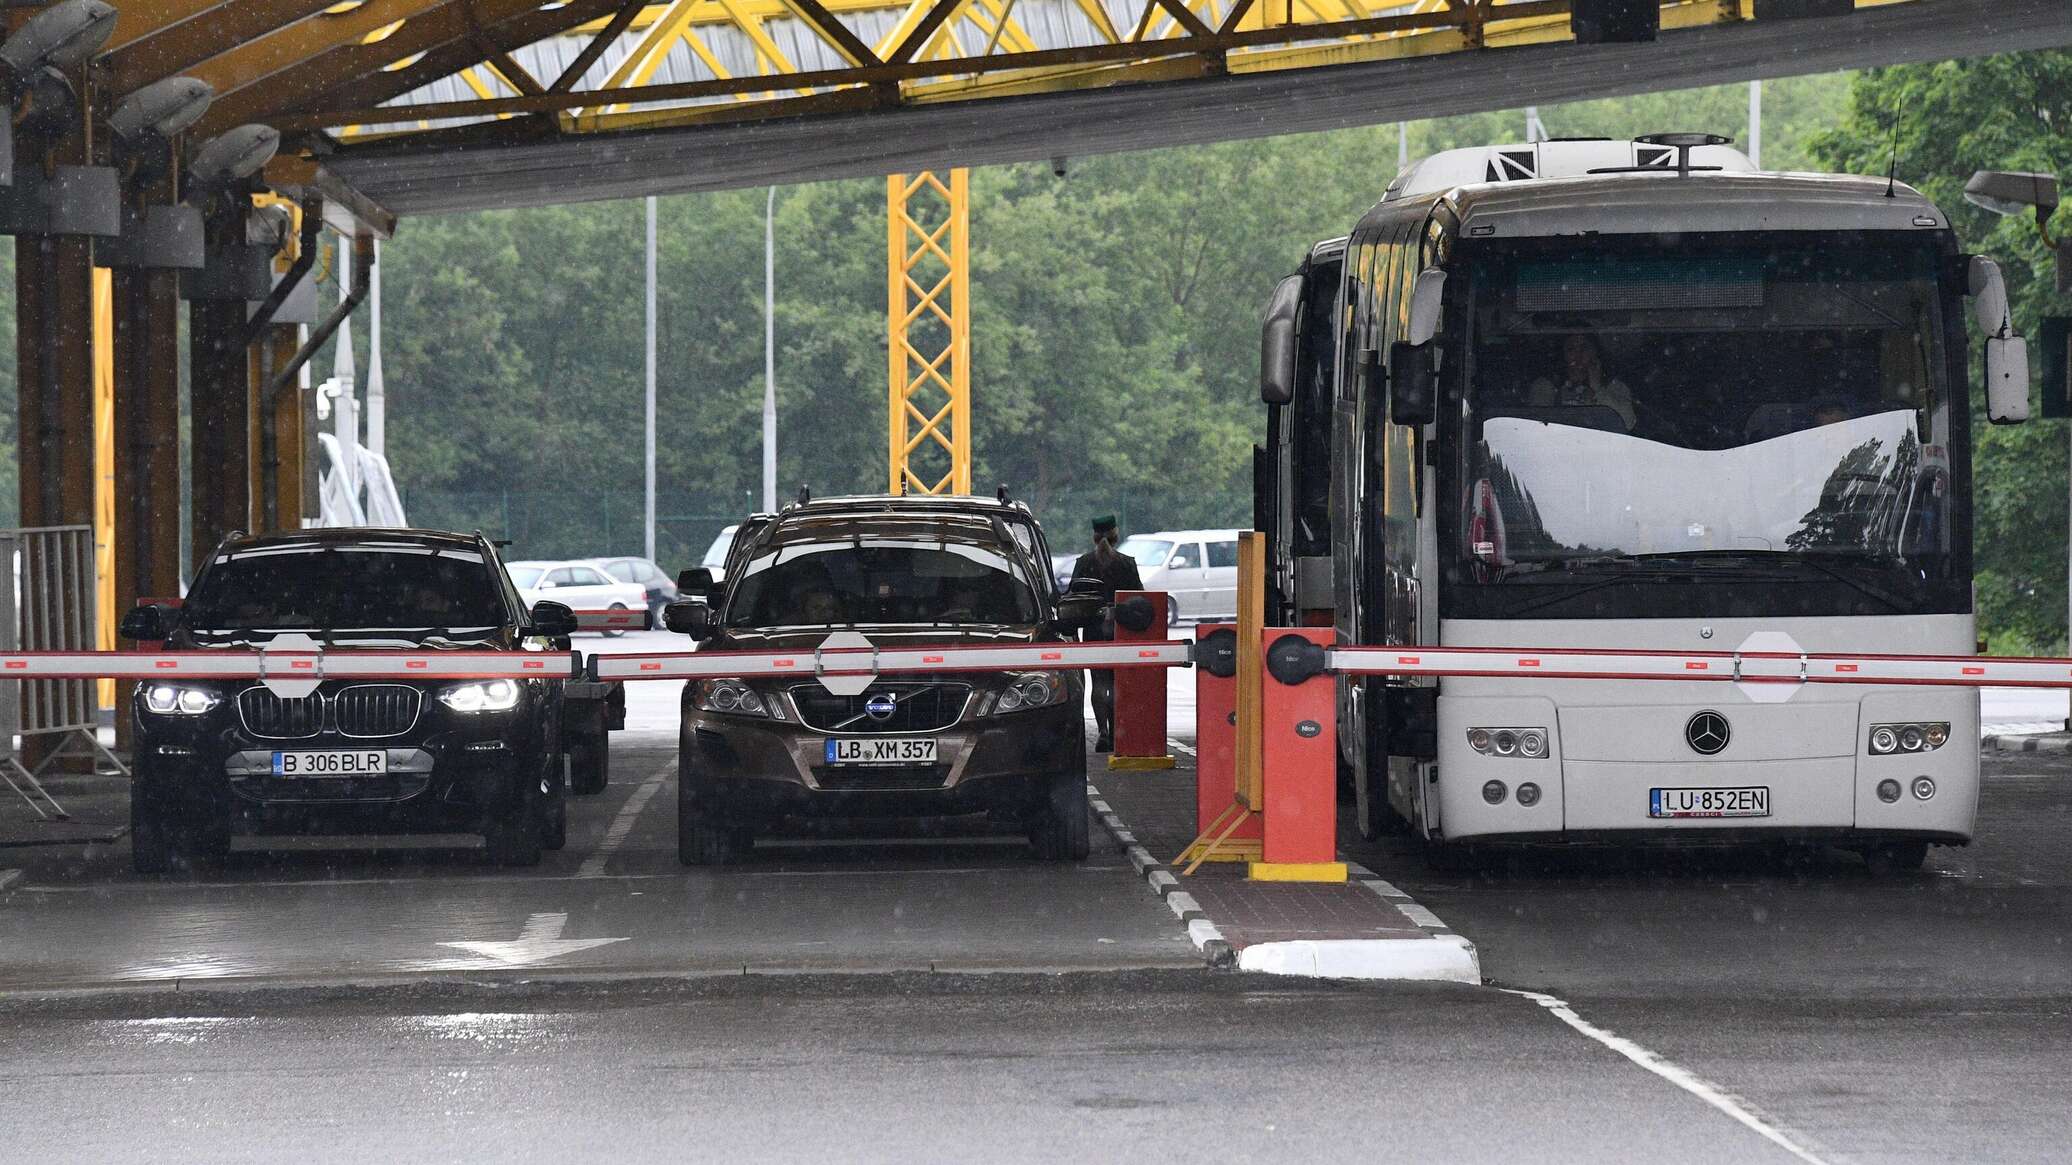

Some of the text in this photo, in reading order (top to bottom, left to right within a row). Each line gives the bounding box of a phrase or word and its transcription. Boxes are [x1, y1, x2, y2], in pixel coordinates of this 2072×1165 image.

[838, 741, 935, 759] LB XM 357
[284, 755, 297, 772] B
[1666, 791, 1764, 810] LU 852EN
